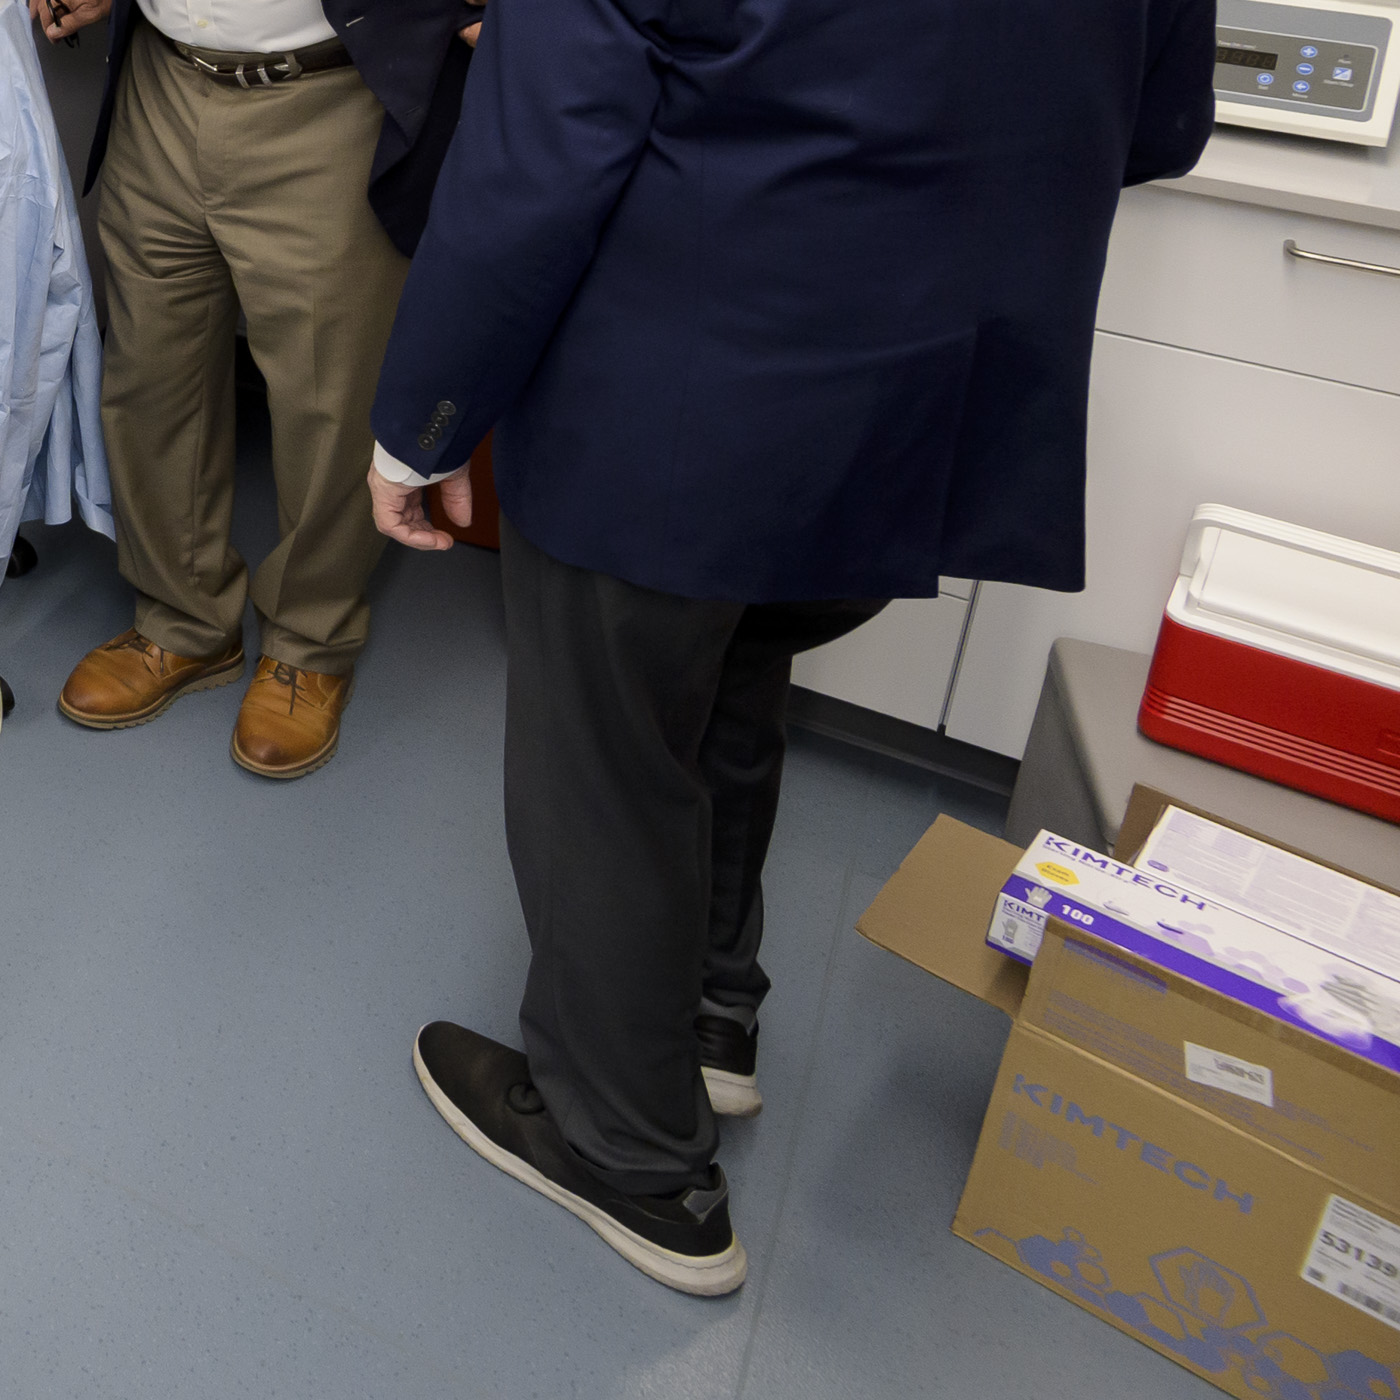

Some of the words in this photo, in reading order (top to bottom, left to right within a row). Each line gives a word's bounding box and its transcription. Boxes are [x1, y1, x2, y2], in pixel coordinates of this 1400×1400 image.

[1045, 836, 1207, 911] KIMTECH
[1004, 900, 1045, 922] KIMT
[1061, 904, 1095, 926] 100
[1013, 1073, 1255, 1215] KIMTECH
